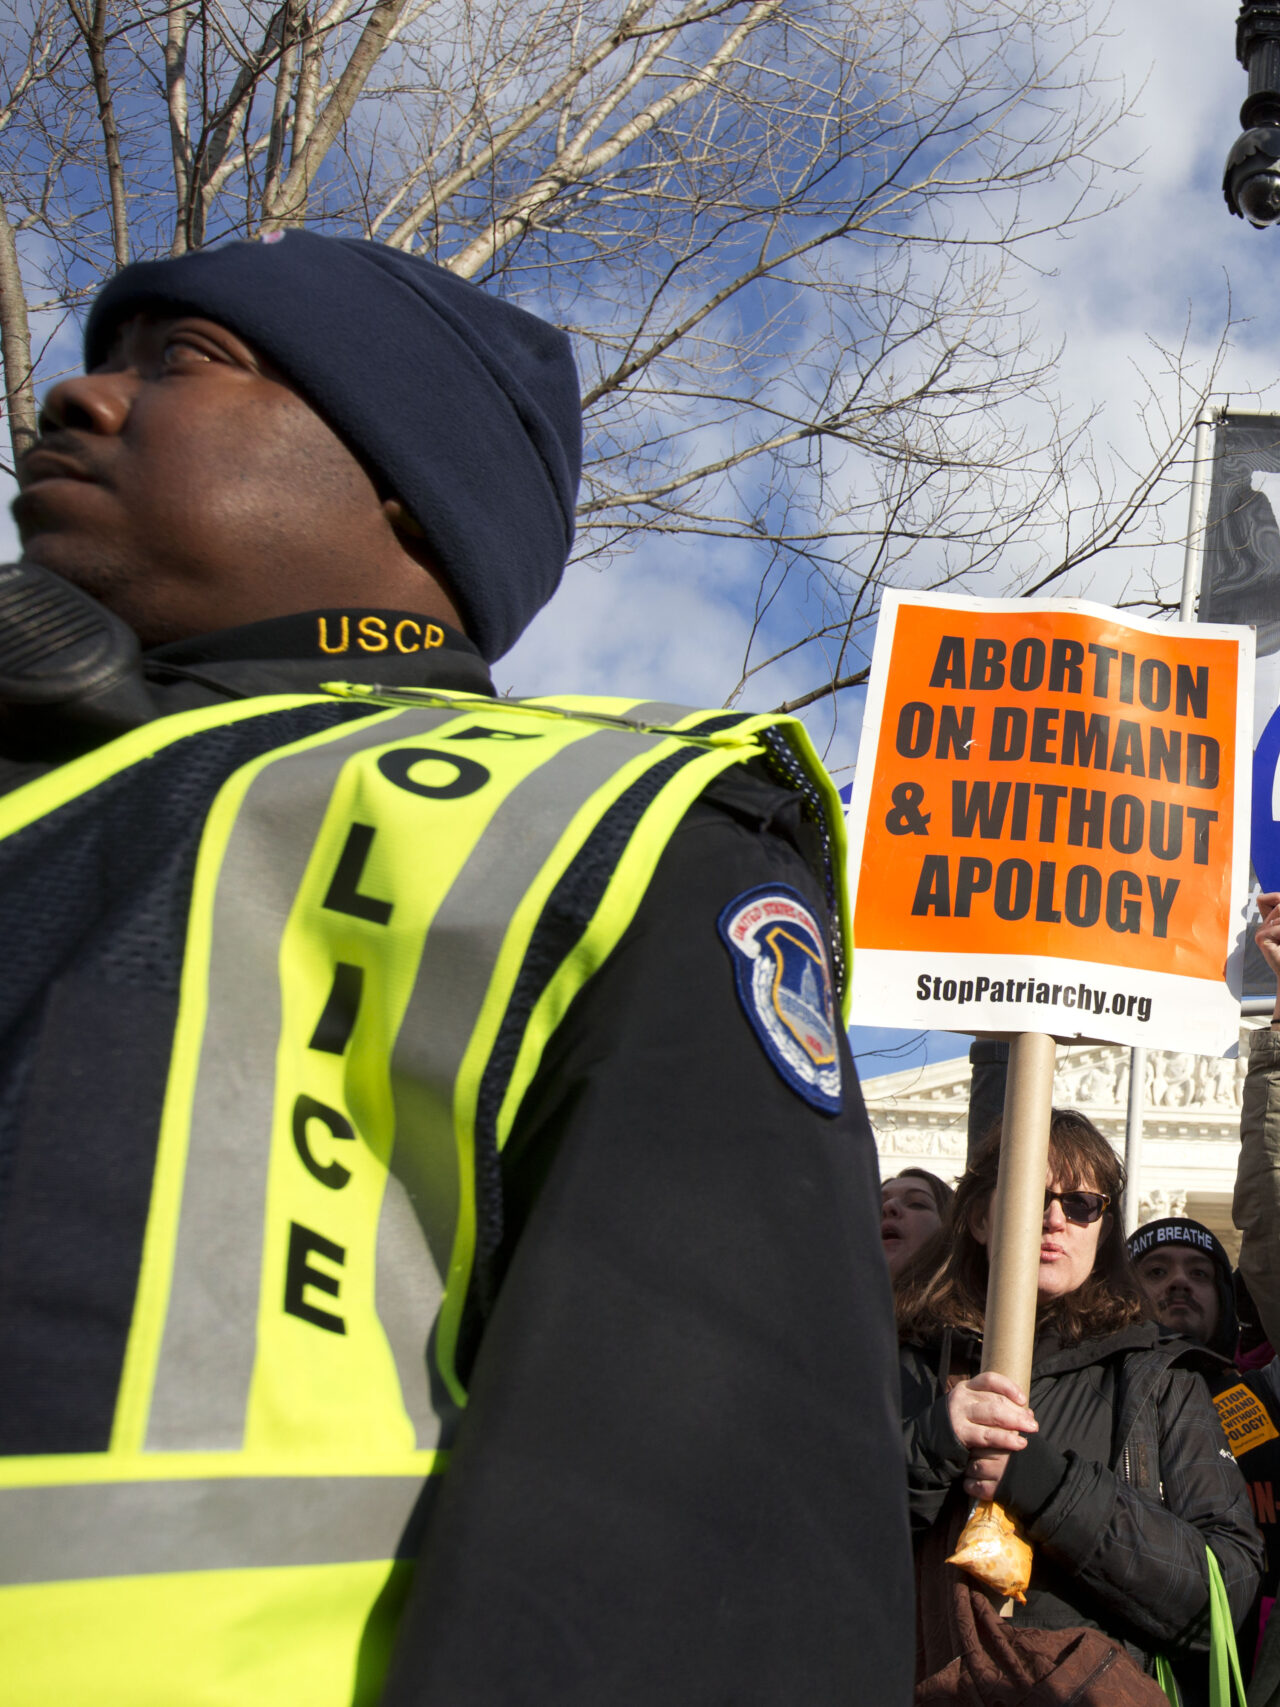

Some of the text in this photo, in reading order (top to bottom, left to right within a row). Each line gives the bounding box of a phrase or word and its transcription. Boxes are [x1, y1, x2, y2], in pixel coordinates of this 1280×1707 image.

[318, 615, 445, 653] USCP
[929, 635, 1209, 719] ABORTION
[895, 702, 1221, 790] ON DEMAND
[885, 780, 1219, 866] & WITHOUT
[911, 855, 1181, 938] APOLOGY
[916, 973, 1152, 1022] StopPatriarchy.org
[283, 725, 545, 1336] POLICE
[1157, 1226, 1213, 1250] BREATHE
[1220, 1396, 1256, 1420] EMAND
[1223, 1405, 1262, 1429] WITHOUT
[1228, 1414, 1270, 1441] OLOGY!
